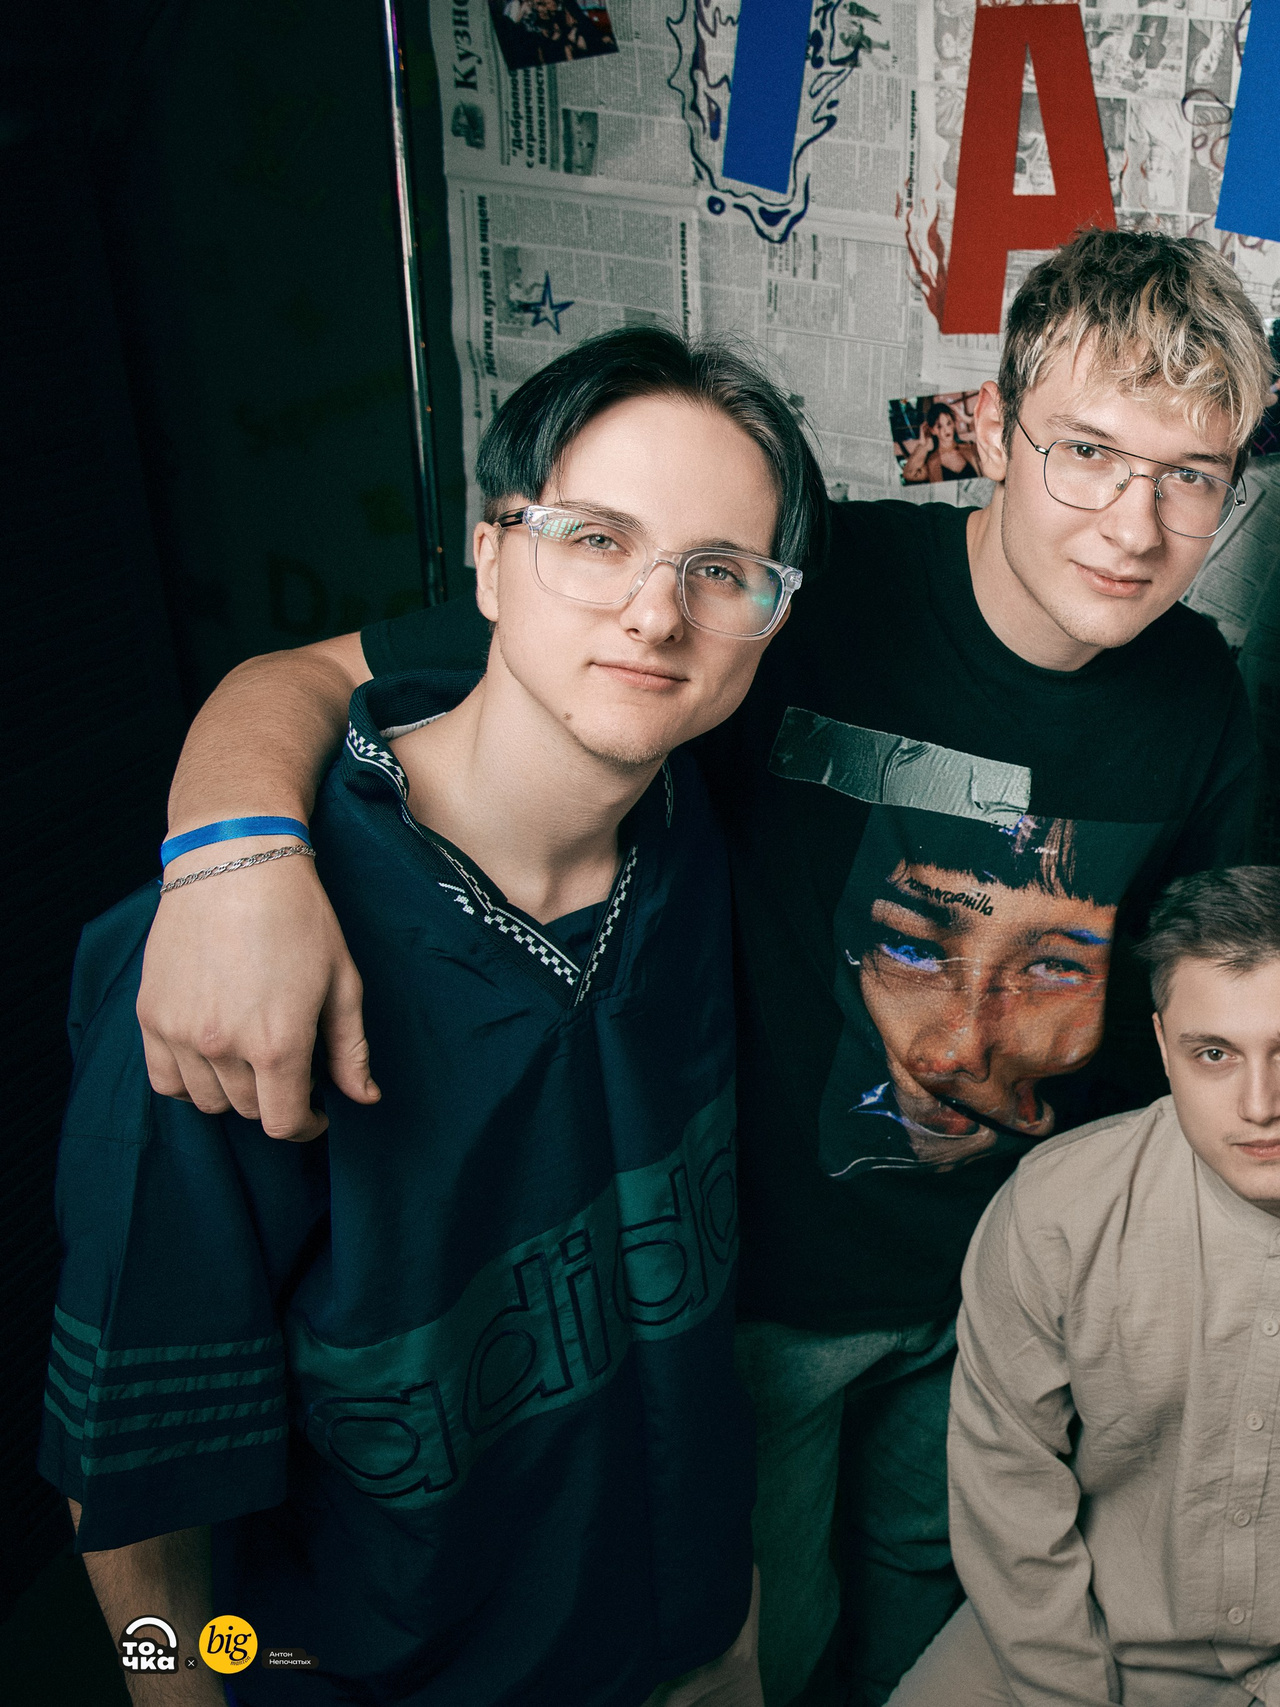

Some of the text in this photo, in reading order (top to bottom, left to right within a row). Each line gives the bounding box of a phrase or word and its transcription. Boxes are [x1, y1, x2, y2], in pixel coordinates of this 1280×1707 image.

[475, 194, 490, 244] ищем
[478, 245, 491, 267] не
[477, 268, 496, 316] путей
